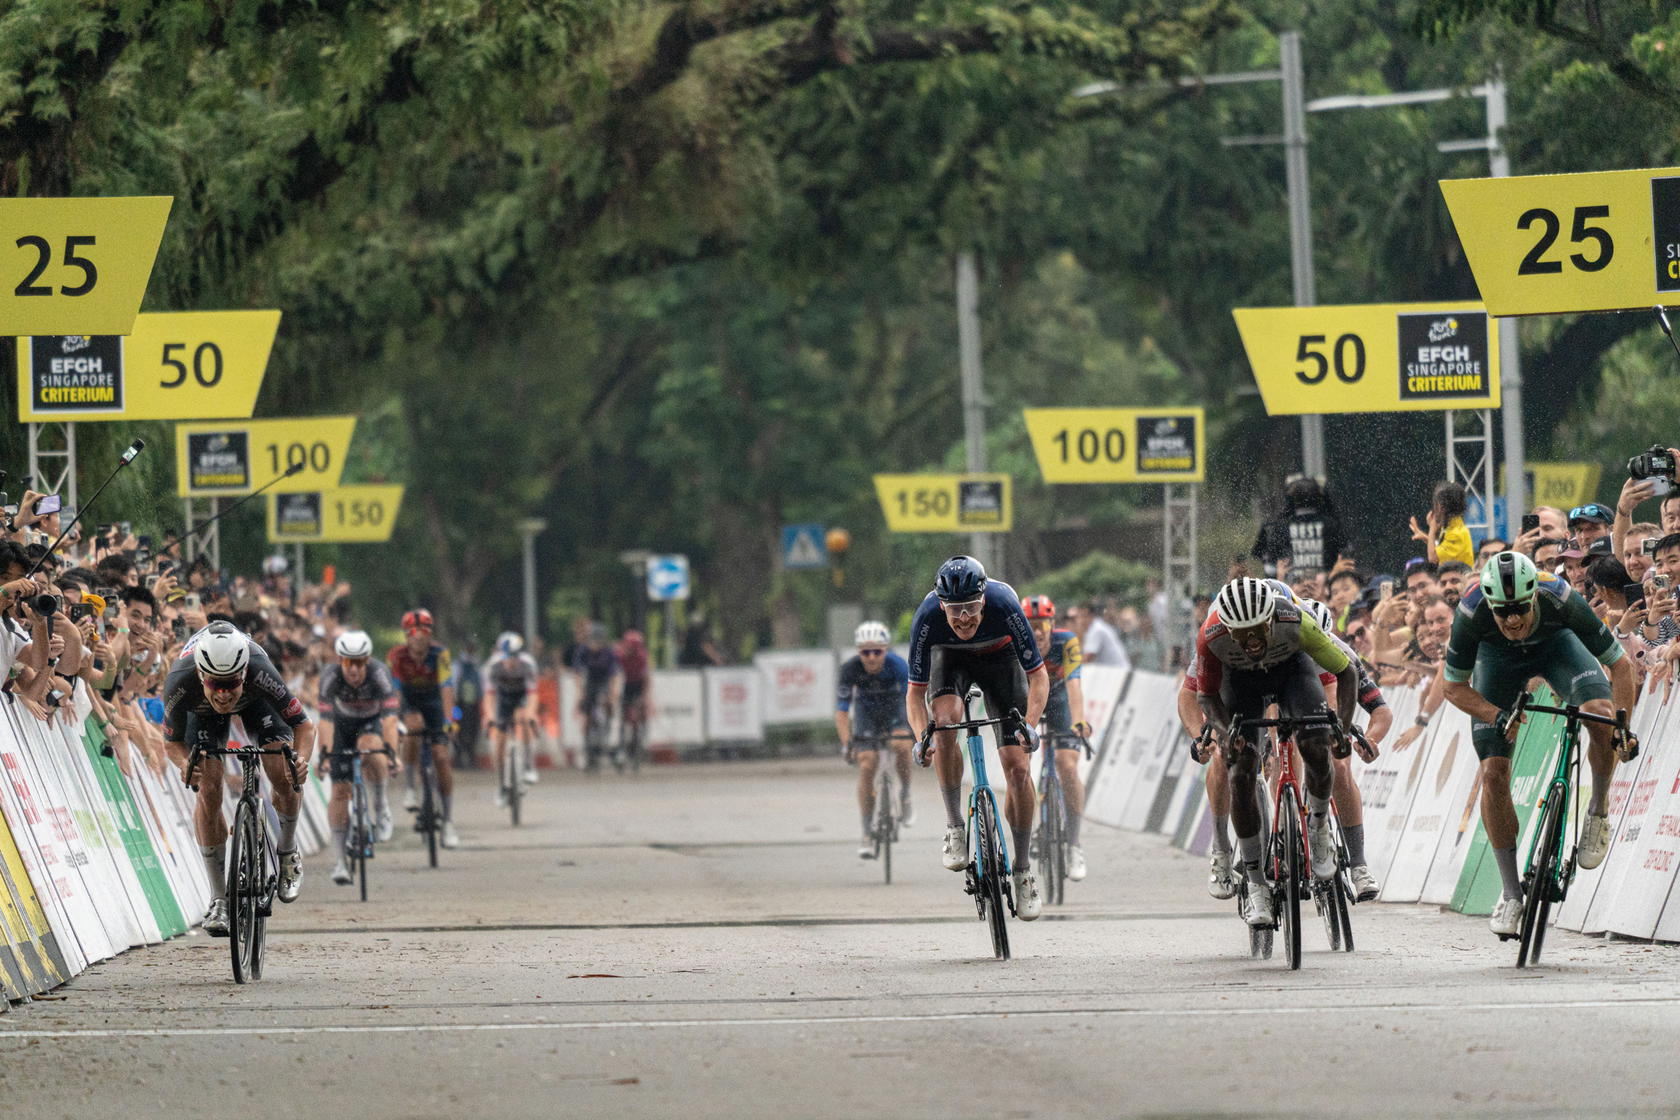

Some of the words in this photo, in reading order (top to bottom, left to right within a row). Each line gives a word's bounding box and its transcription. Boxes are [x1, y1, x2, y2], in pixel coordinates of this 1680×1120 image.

[1516, 205, 1615, 276] 25
[14, 235, 98, 297] 25
[160, 342, 223, 388] 50
[1294, 332, 1366, 385] 50
[1417, 346, 1469, 363] EFGH
[51, 357, 102, 374] EFGH
[1407, 361, 1481, 377] SINGAPORE
[40, 373, 114, 387] SINGAPORE
[1407, 375, 1482, 392] CRITERIUM
[40, 387, 114, 403] CRITERIUM
[1052, 428, 1126, 463] 100
[266, 441, 330, 475] 100
[335, 500, 384, 526] 150
[896, 488, 951, 517] 150
[1289, 521, 1324, 538] BEST
[1290, 539, 1324, 553] TEAM
[1292, 553, 1324, 567] MATE
[254, 669, 287, 699] Alpecin
